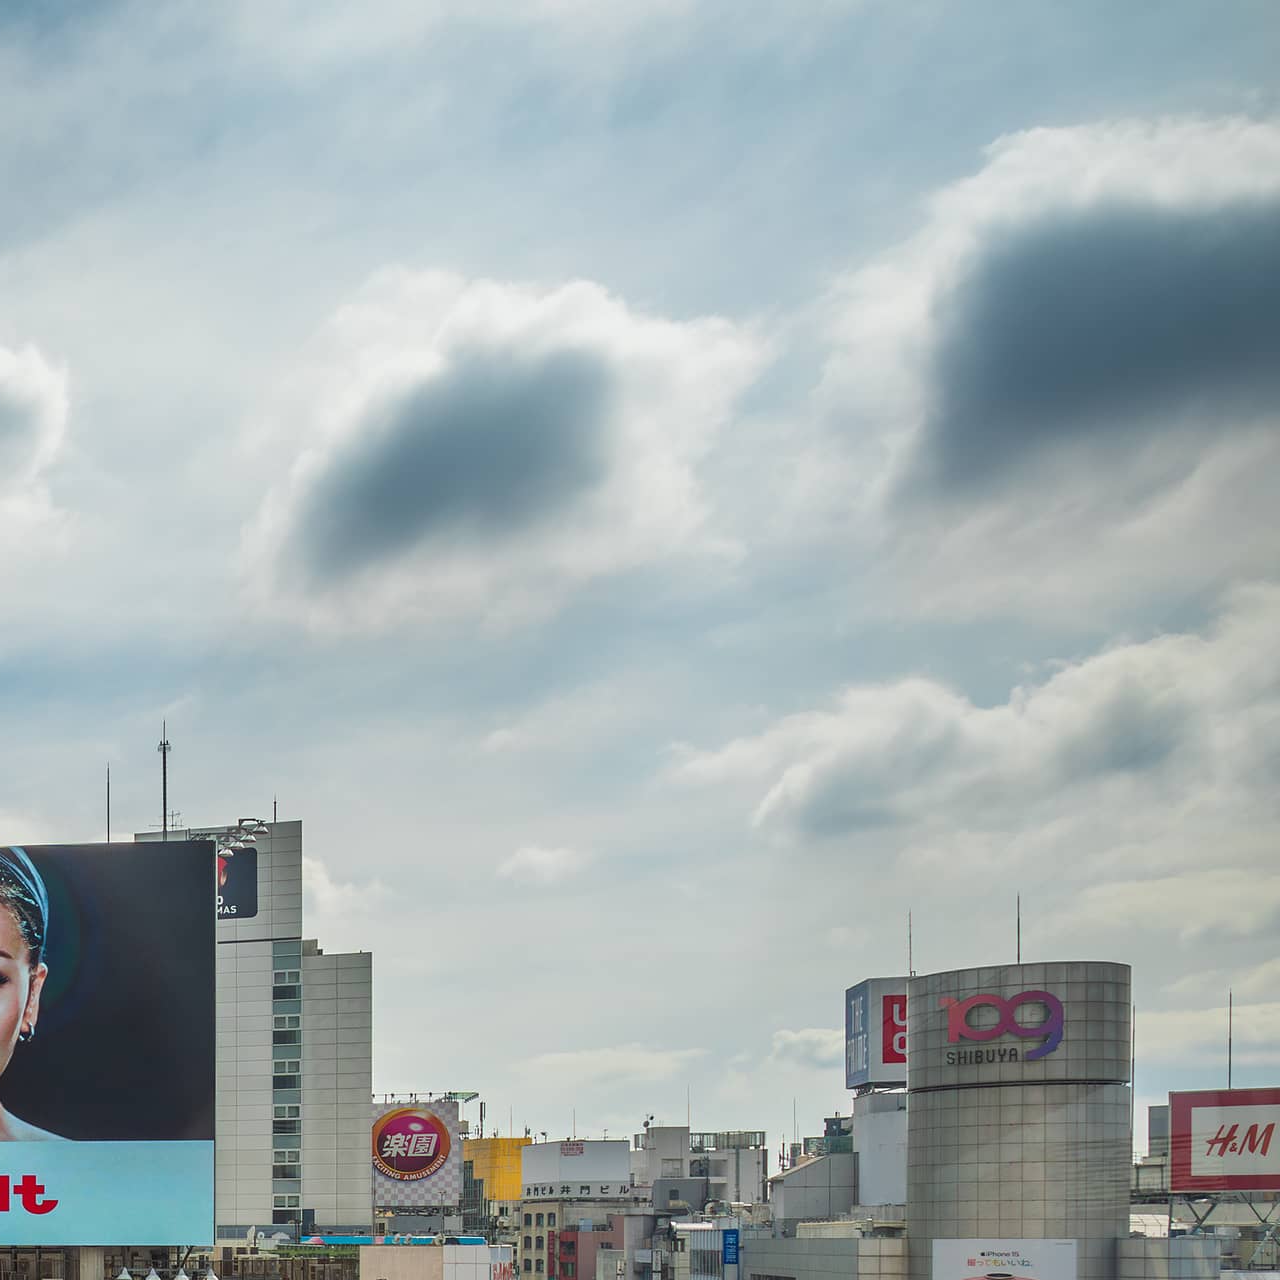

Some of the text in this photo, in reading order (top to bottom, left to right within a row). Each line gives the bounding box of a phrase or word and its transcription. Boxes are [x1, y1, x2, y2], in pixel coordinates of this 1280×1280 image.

[940, 990, 1064, 1060] 109
[946, 1047, 1019, 1065] SHIBUYA
[382, 1133, 439, 1158] 楽園
[1206, 1122, 1276, 1157] H&M
[560, 1185, 630, 1195] 井門ビル
